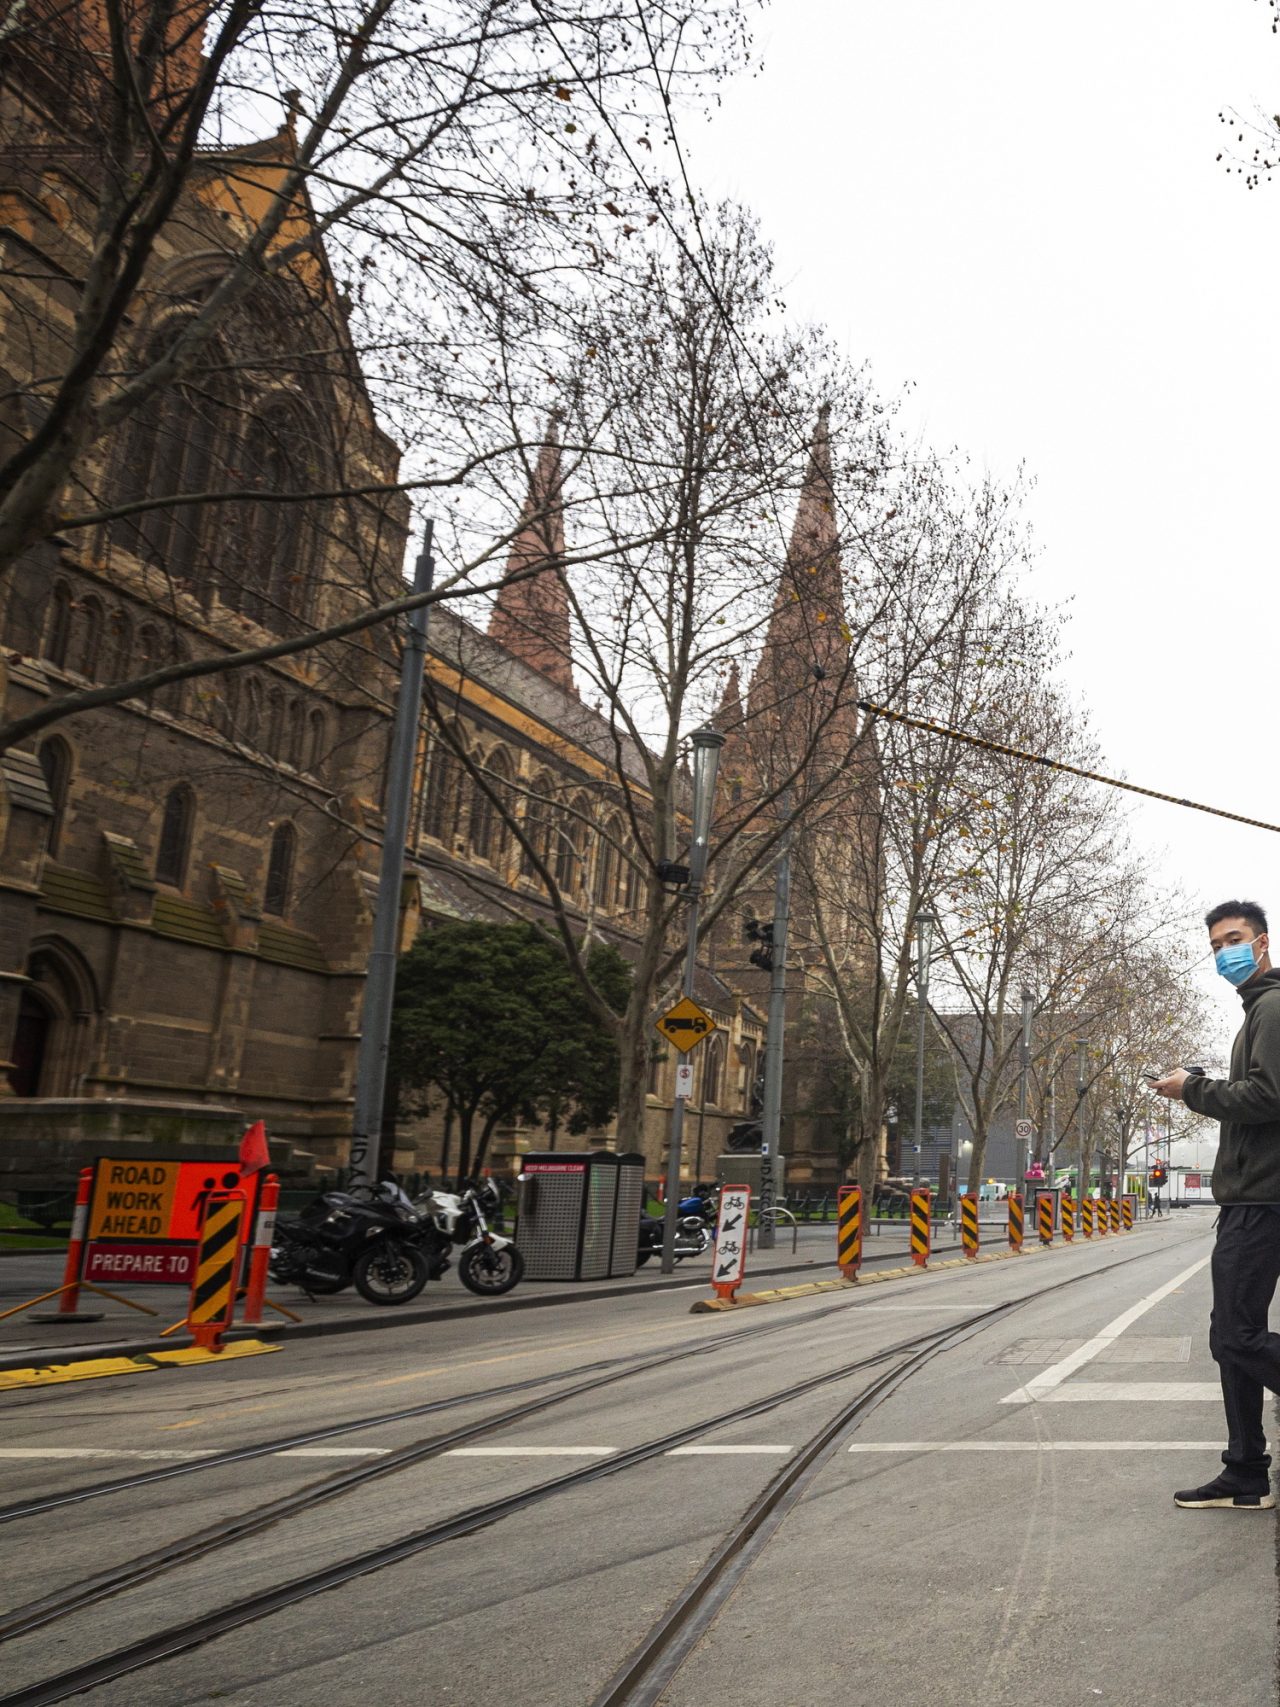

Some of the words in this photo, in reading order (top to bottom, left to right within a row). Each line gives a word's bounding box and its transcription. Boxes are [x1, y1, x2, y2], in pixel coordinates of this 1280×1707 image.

[1019, 1125, 1029, 1133] 30
[110, 1165, 167, 1186] ROAD
[106, 1191, 164, 1211] WORK
[100, 1215, 163, 1235] AHEAD
[91, 1253, 165, 1273] PREPARE
[168, 1256, 190, 1274] TO
